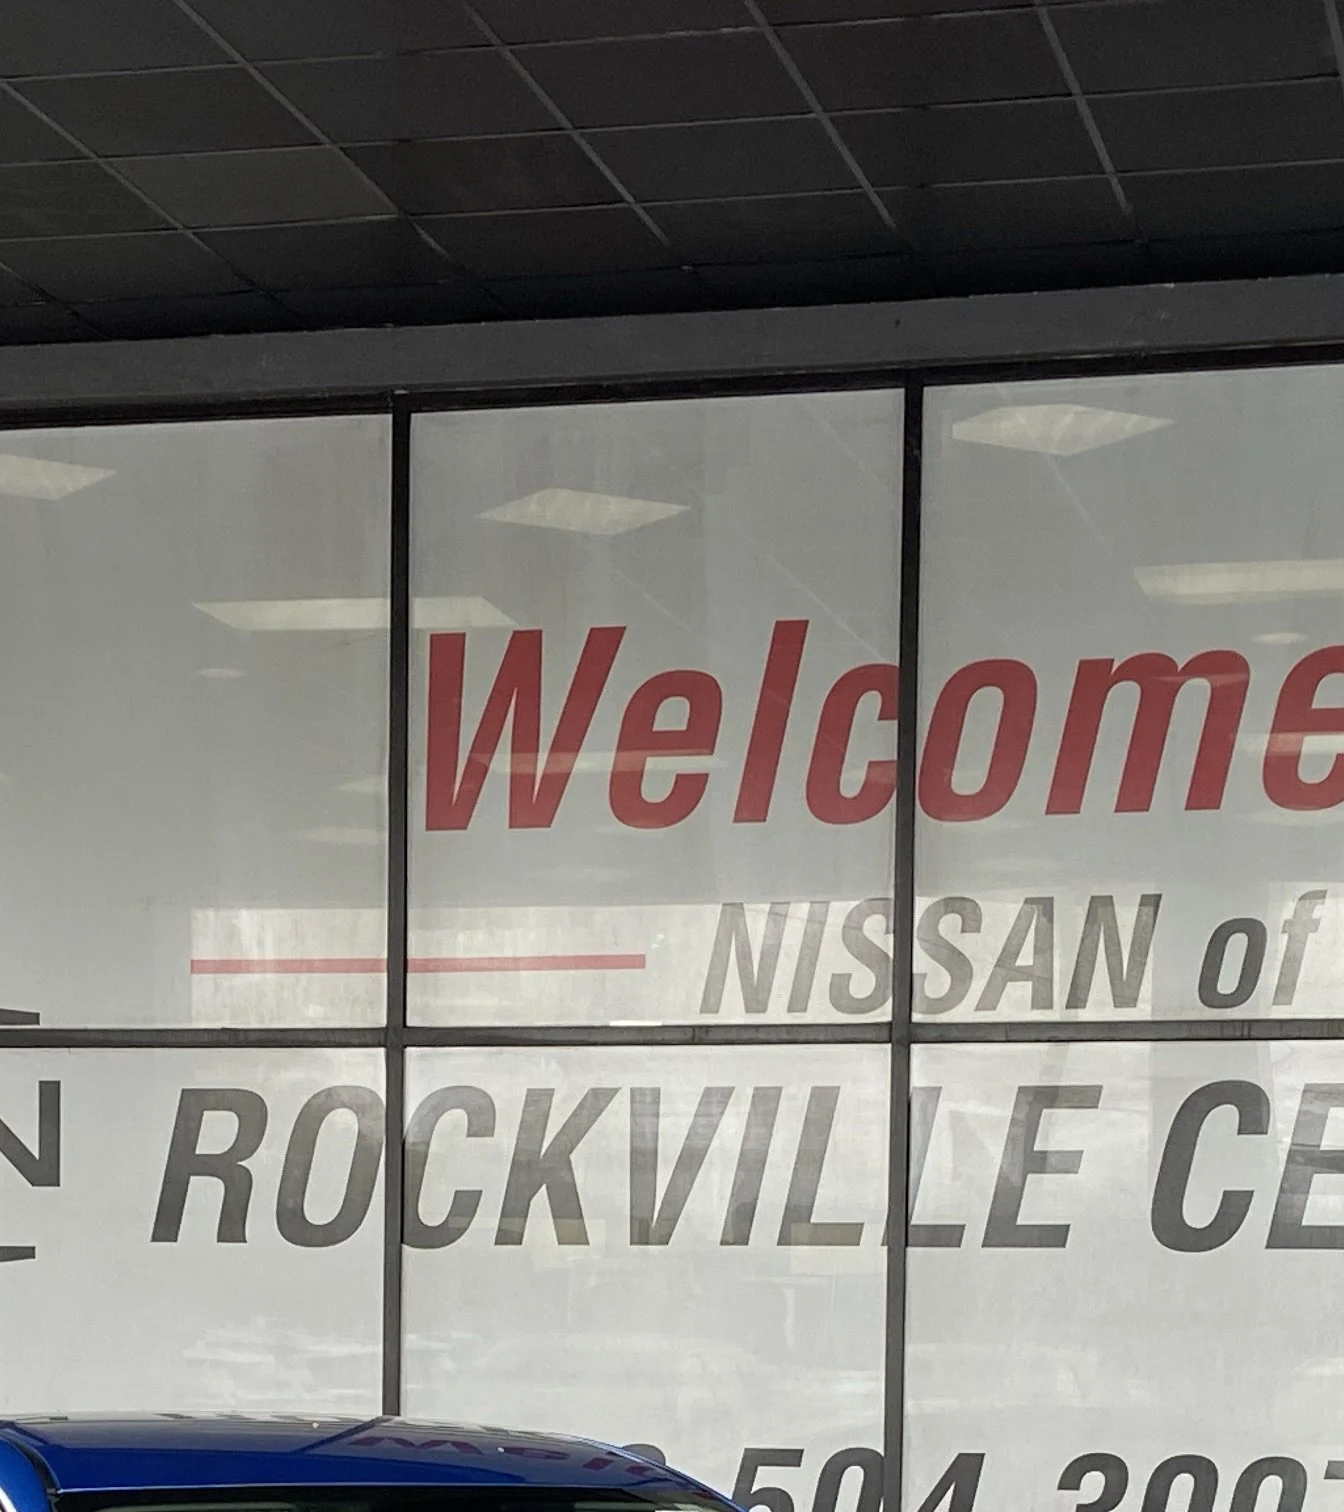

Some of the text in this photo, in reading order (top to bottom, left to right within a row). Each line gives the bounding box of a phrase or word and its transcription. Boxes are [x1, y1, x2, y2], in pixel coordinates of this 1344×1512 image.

[699, 890, 1328, 1017] NISSAN of
[150, 1083, 1103, 1253] ROCKVILLE
